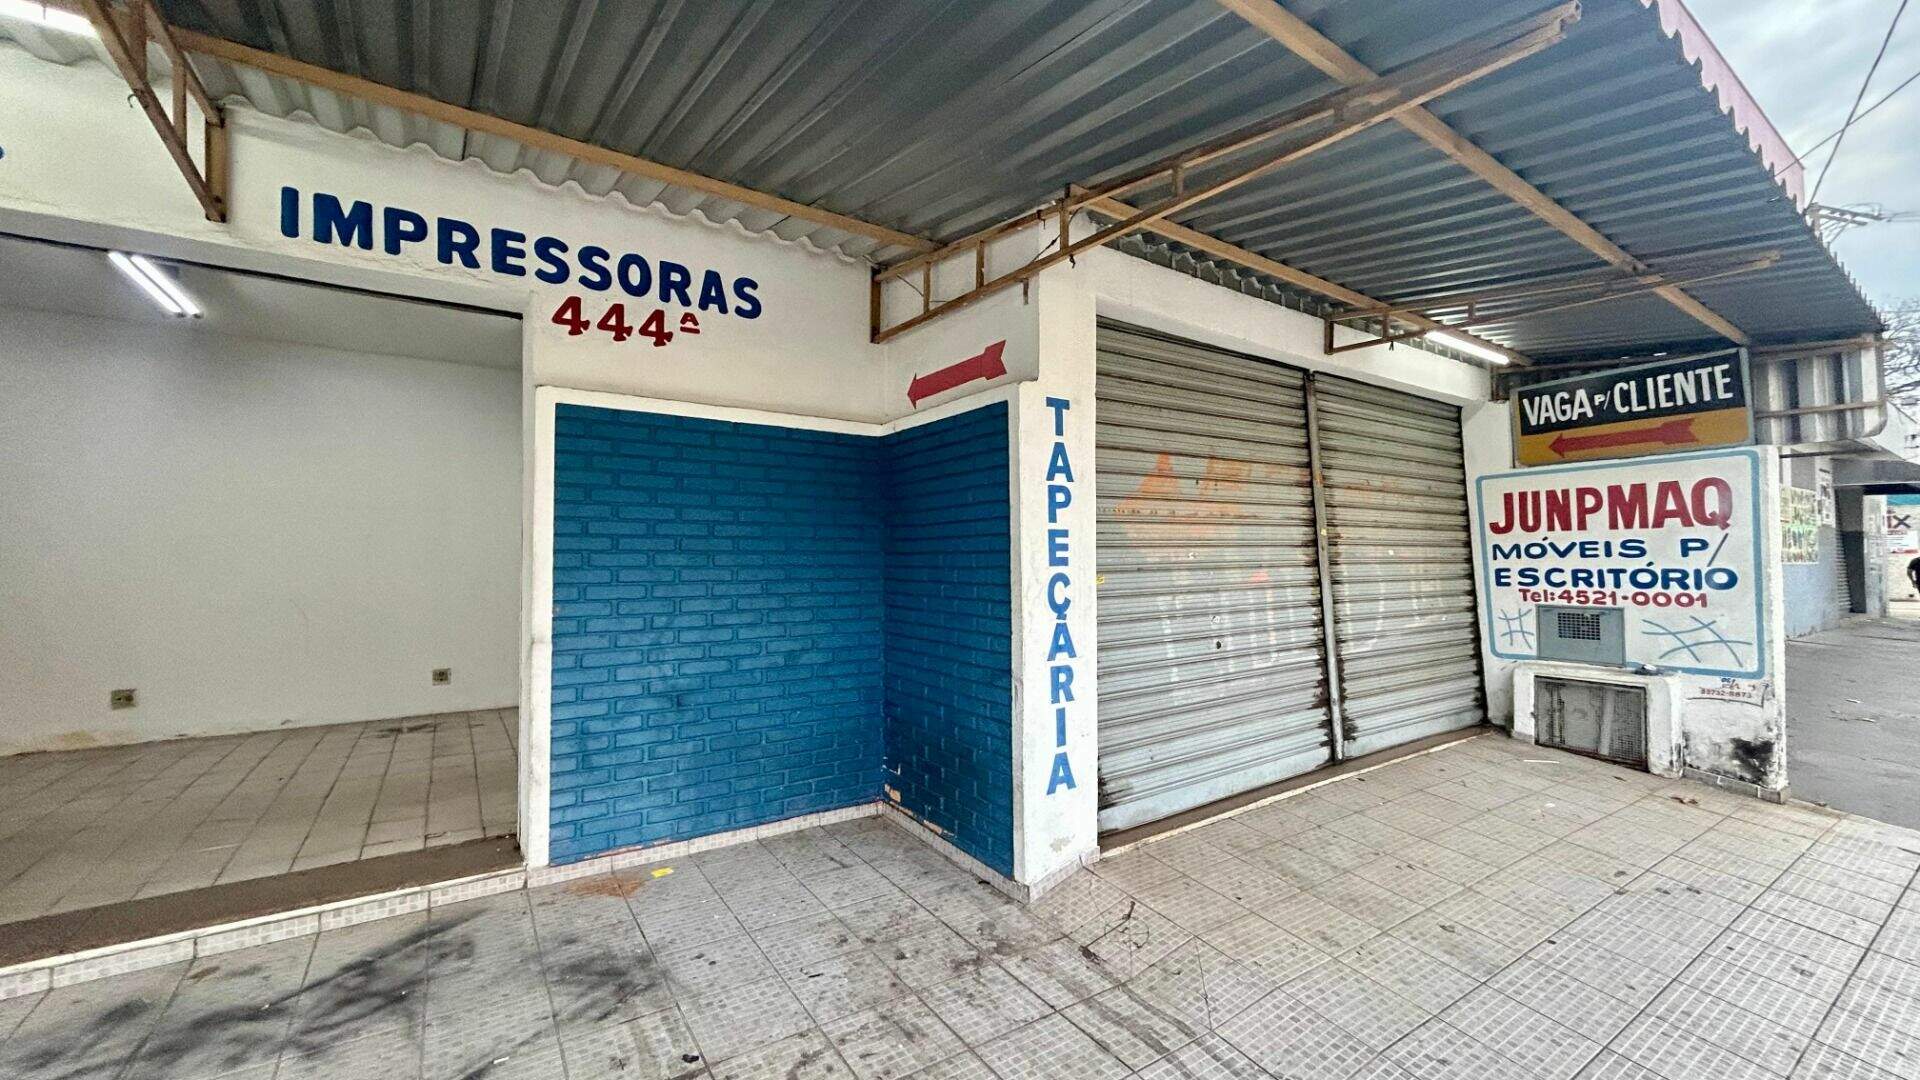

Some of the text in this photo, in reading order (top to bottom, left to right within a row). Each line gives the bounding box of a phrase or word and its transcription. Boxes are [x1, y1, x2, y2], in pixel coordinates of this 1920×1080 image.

[281, 187, 762, 320] IMPRESSORAS
[1523, 388, 1593, 426] VAGA
[1613, 364, 1734, 413] CLIENTE
[1489, 477, 1733, 535] JUNPMAQ
[1492, 533, 1729, 567] MÓVEIS P/
[1495, 561, 1738, 590] ESCRITÓRIO
[1045, 397, 1077, 796] TAPEÇARIA
